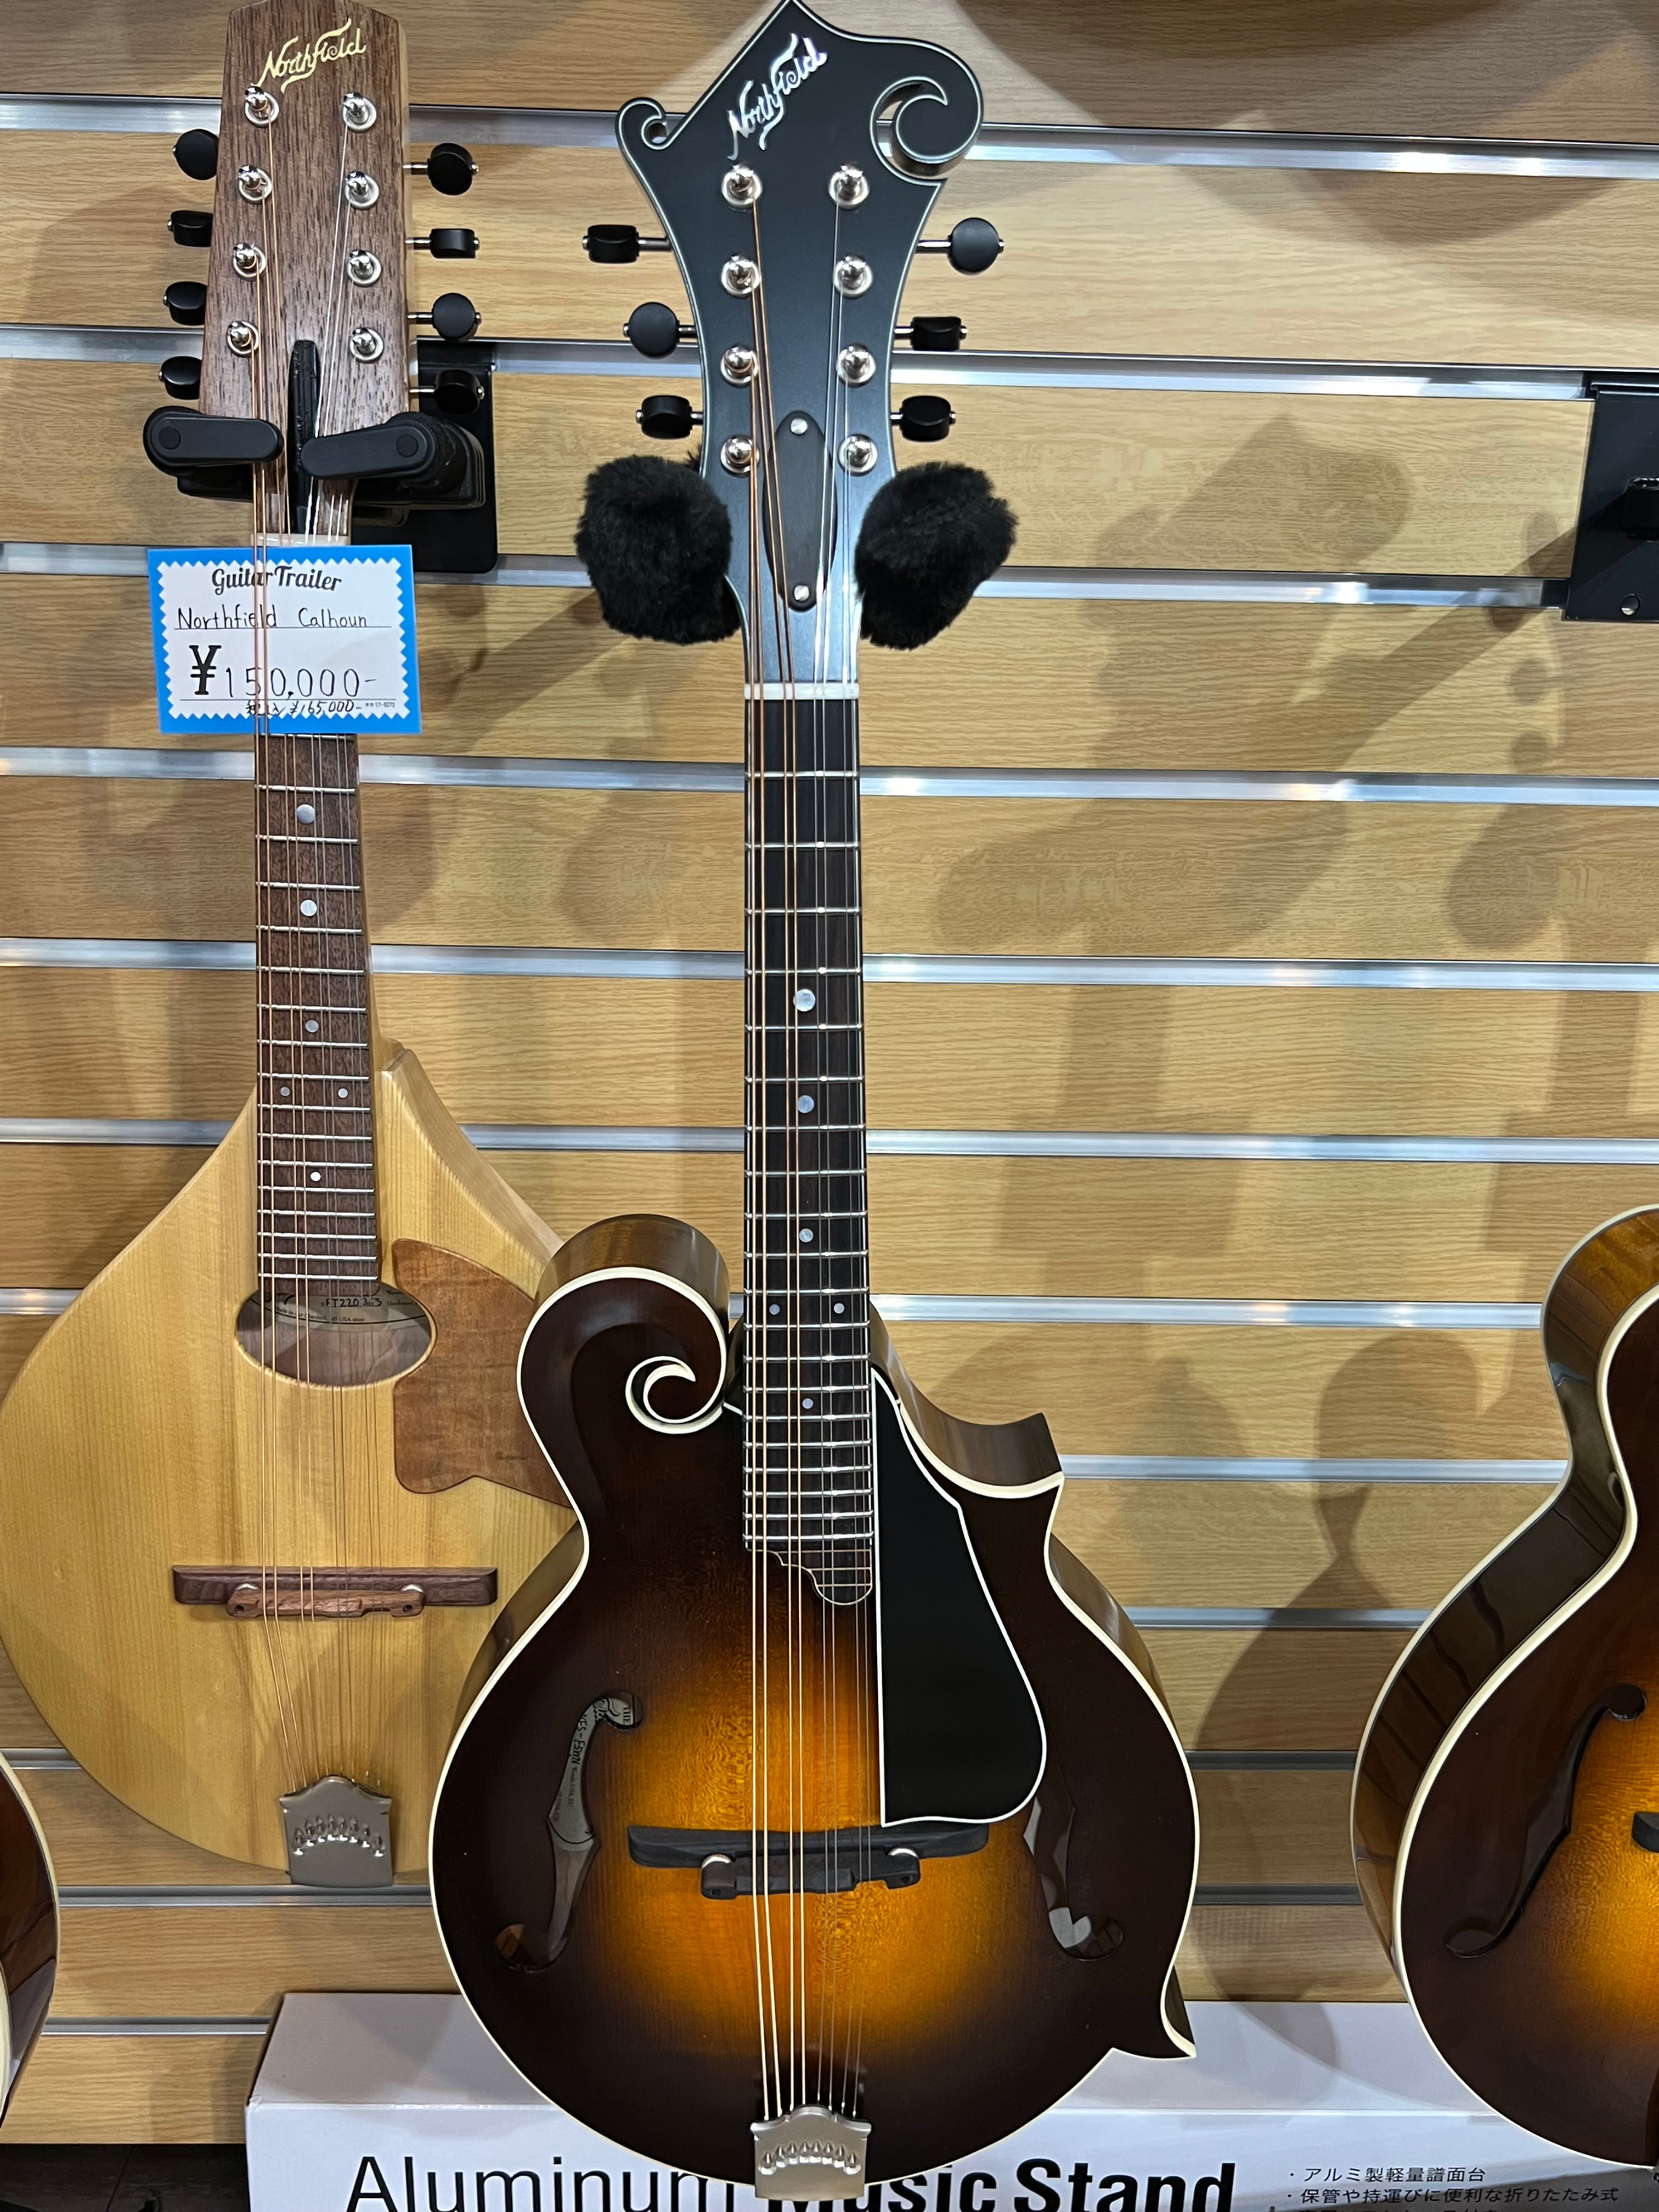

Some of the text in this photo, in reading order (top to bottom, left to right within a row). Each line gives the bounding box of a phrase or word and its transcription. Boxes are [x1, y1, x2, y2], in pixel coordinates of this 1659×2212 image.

[251, 18, 366, 94] Northfield
[727, 33, 828, 160] Northfield
[212, 565, 342, 596] Guitar Trailer
[177, 603, 368, 629] Northfield Calhoun
[347, 2155, 1235, 2212] Aluminum usic Stand
